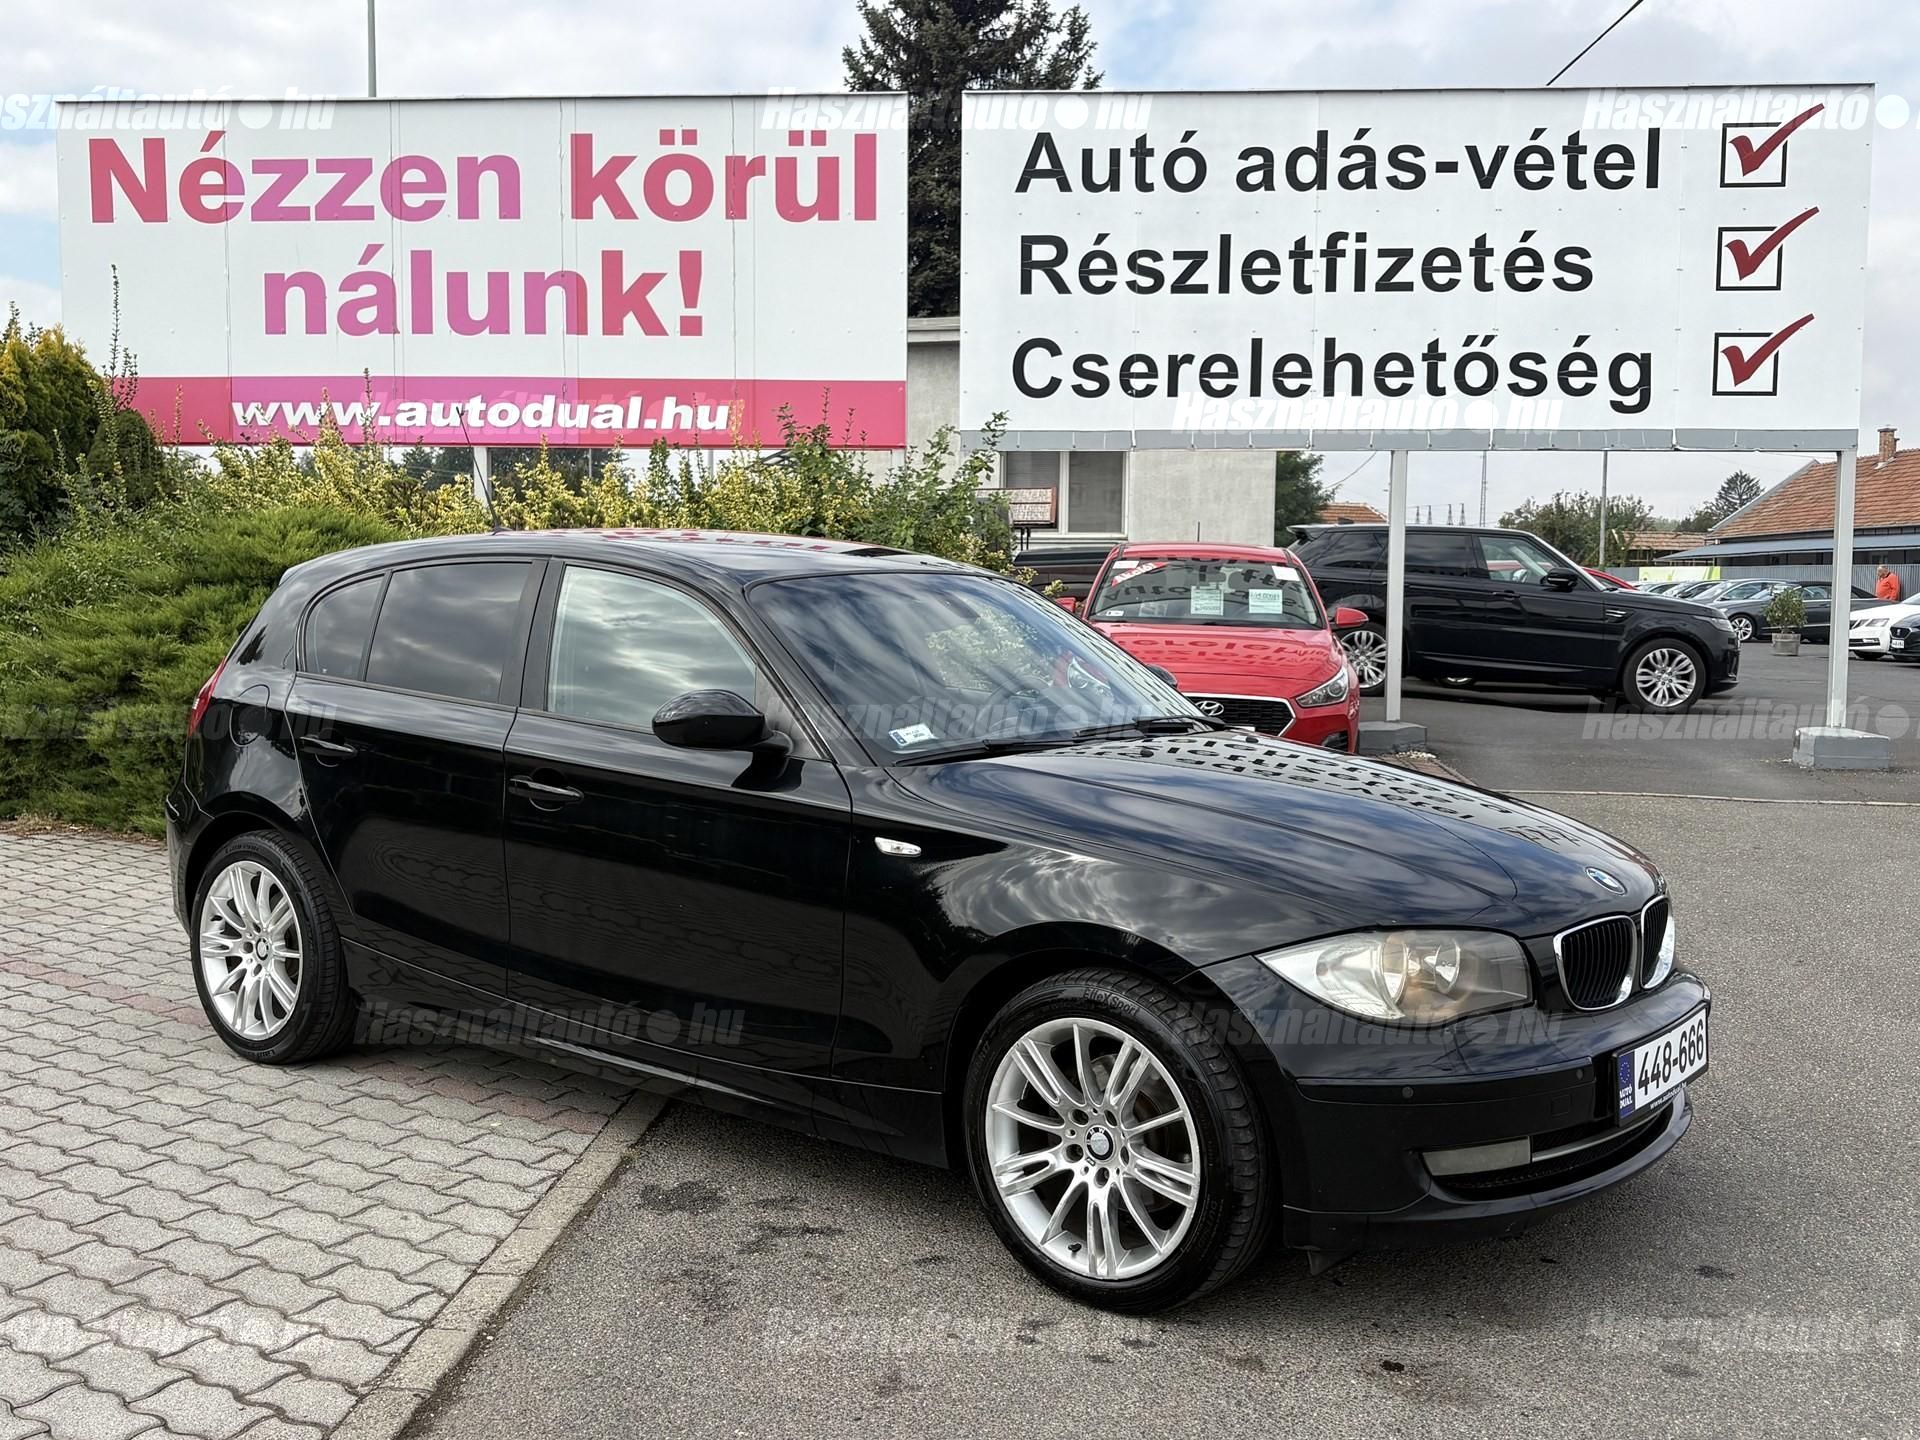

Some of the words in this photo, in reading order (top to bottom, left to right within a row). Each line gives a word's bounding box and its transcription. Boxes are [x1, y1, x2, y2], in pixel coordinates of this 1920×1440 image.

[88, 130, 521, 223] Nézzen
[570, 128, 877, 222] körül
[1014, 130, 1207, 193] Autó
[1235, 127, 1660, 192] adás-vétel
[264, 243, 703, 337] nálunk!
[1019, 230, 1593, 295] Részletfizetés
[231, 394, 731, 432] www.autodual.hu
[1012, 335, 1652, 414] Cserelehetőség
[1638, 1019, 1704, 1096] 448-666
